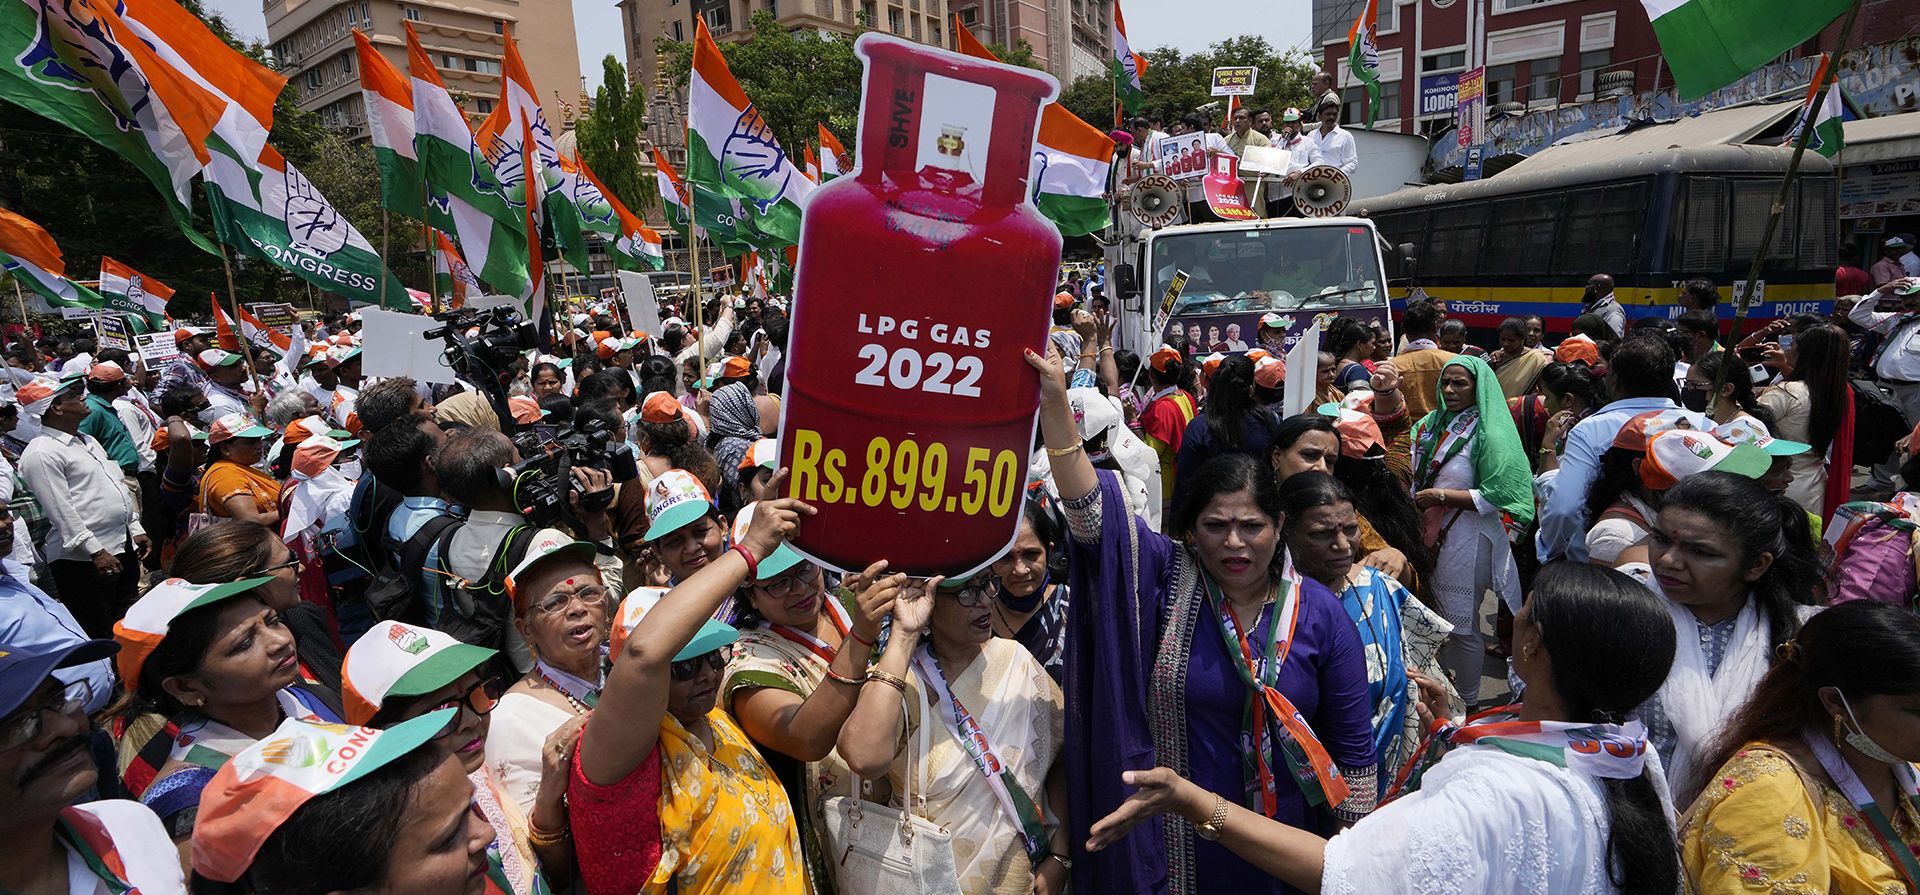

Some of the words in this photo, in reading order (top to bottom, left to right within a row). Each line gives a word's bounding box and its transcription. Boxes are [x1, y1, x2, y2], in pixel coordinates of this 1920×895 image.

[1137, 177, 1176, 193] ROSE
[1301, 167, 1344, 184] ROSE
[1132, 205, 1178, 224] SOUND
[1295, 197, 1343, 218] SOUND
[1451, 300, 1500, 314] पोलीस
[1775, 302, 1820, 316] POLICE
[857, 313, 919, 340] LPG
[930, 323, 991, 349] GAS
[855, 343, 984, 398] 2022
[788, 429, 1018, 517] Rs.899.50
[650, 491, 698, 520] CONGRESS
